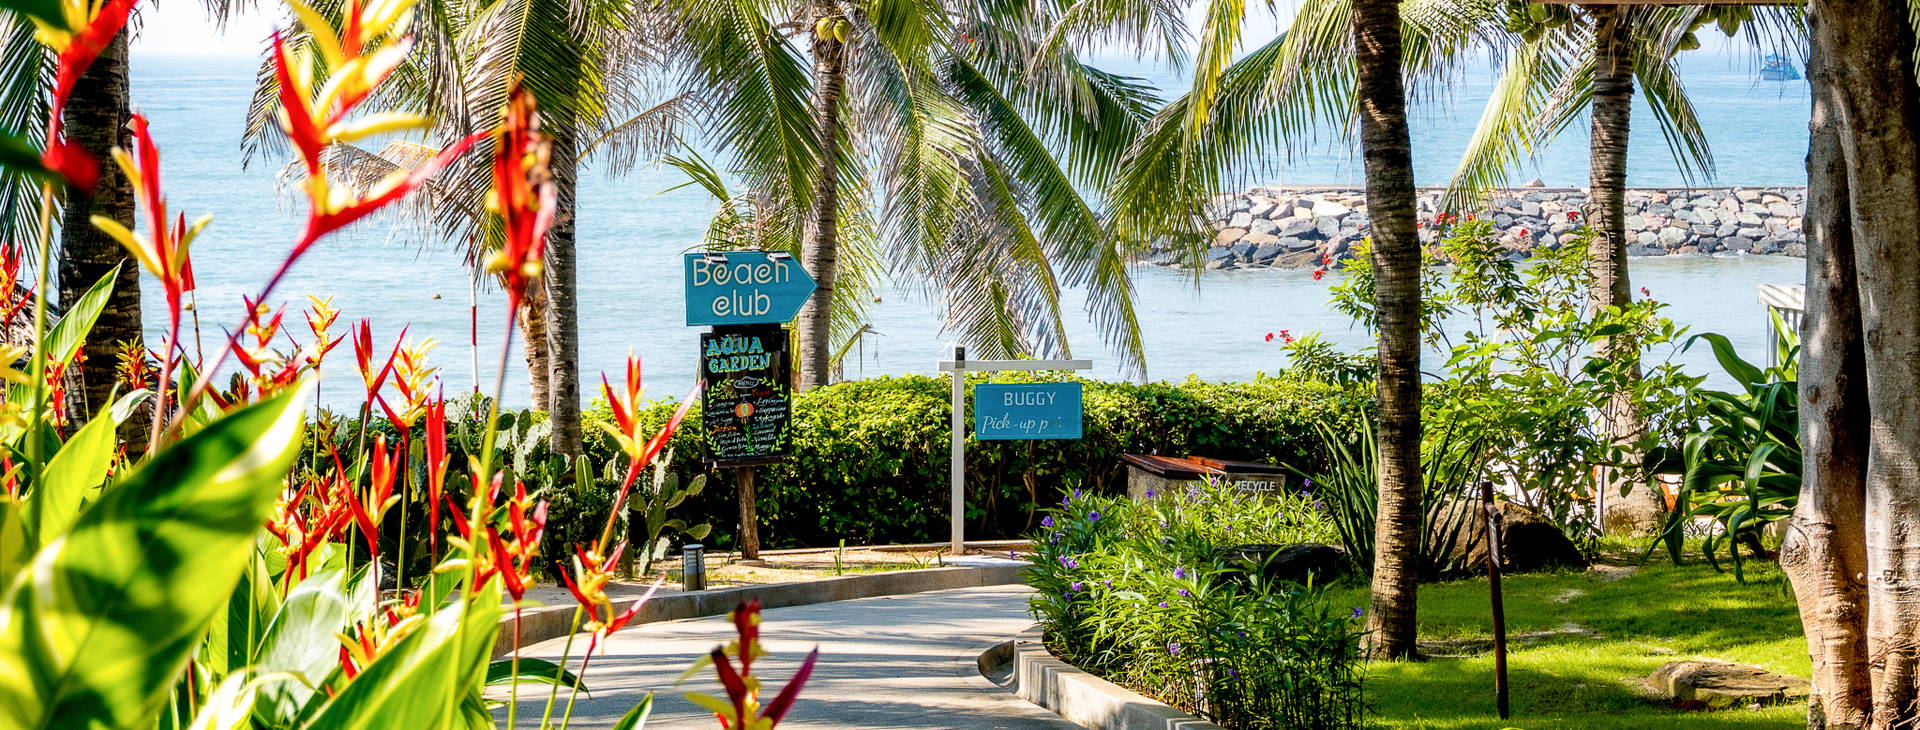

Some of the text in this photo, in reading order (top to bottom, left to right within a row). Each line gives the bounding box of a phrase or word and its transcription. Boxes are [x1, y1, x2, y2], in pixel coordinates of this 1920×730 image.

[706, 336, 764, 357] AQUA
[708, 352, 772, 373] GARDEN
[1004, 391, 1056, 406] BUGGY
[981, 411, 1036, 434] Pick-up
[1234, 480, 1276, 491] RECYCLE
